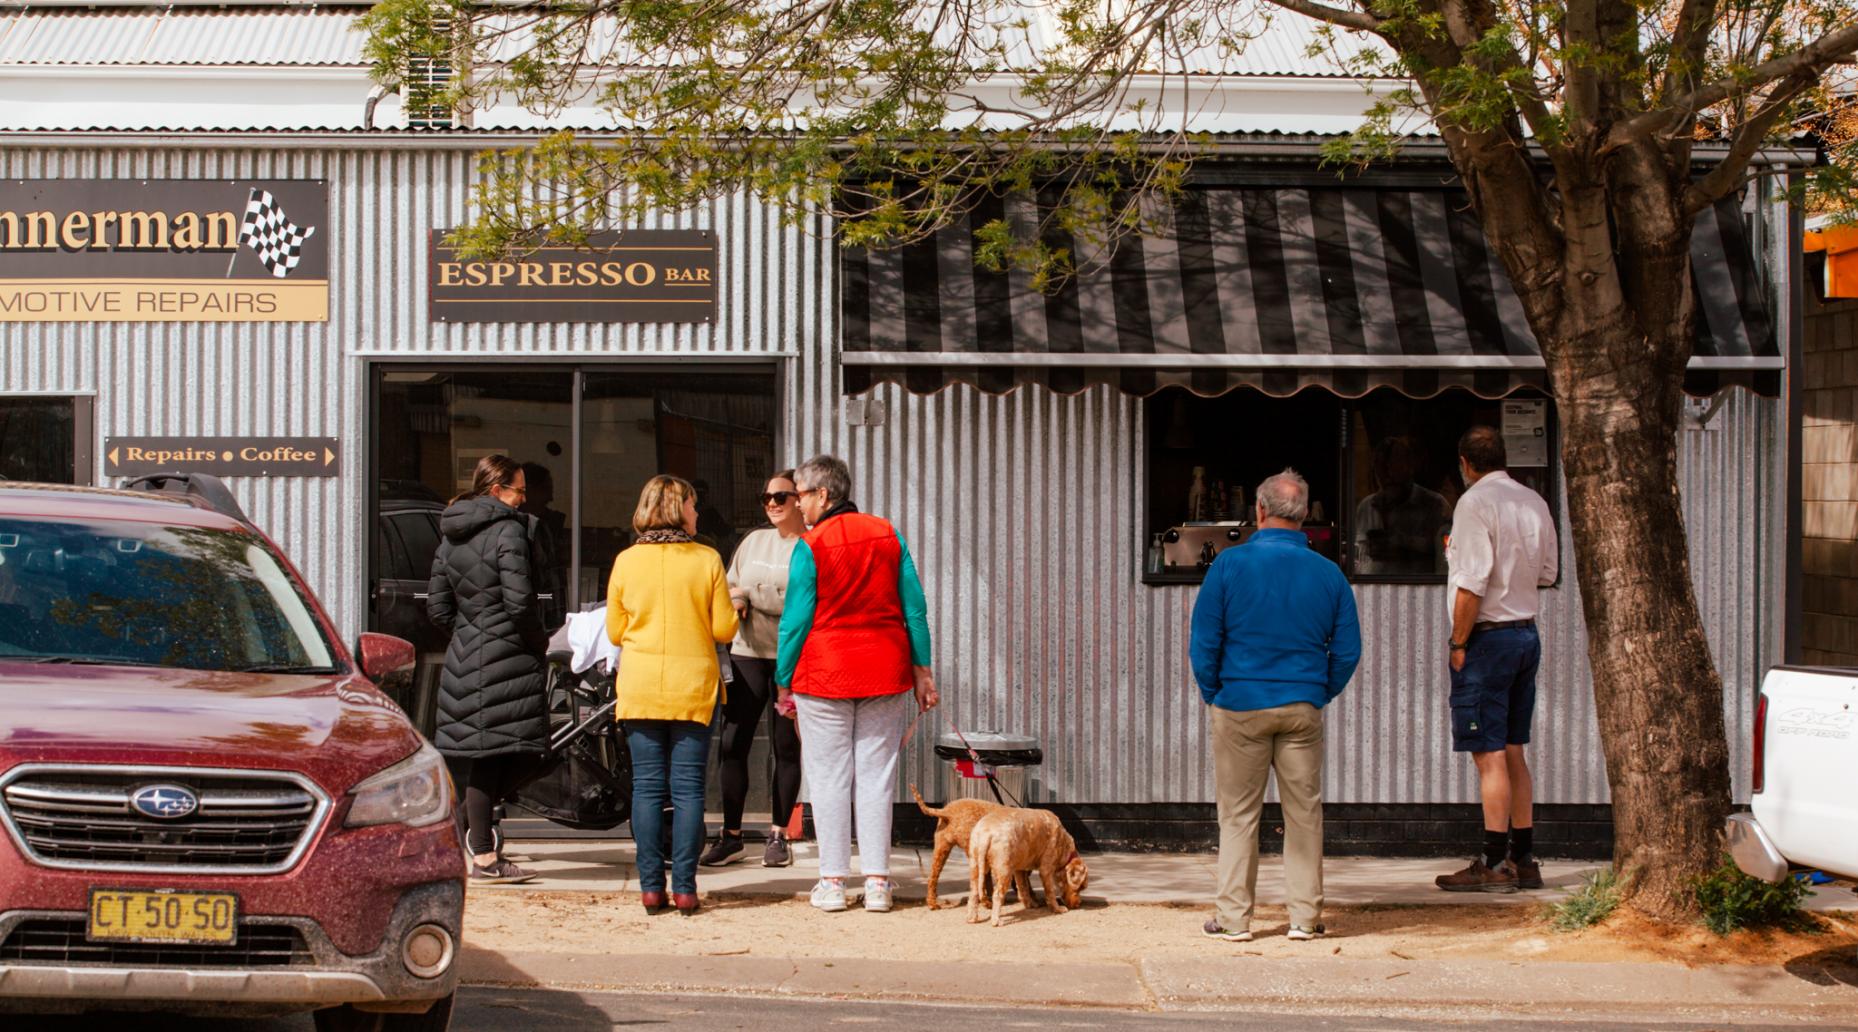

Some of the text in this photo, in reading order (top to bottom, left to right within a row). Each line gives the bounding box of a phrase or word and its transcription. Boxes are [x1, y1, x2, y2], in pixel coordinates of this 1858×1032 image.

[437, 262, 711, 287] ESPRESSO BAR
[137, 291, 277, 313] REPAIRS
[126, 447, 317, 464] Repairs Coffee
